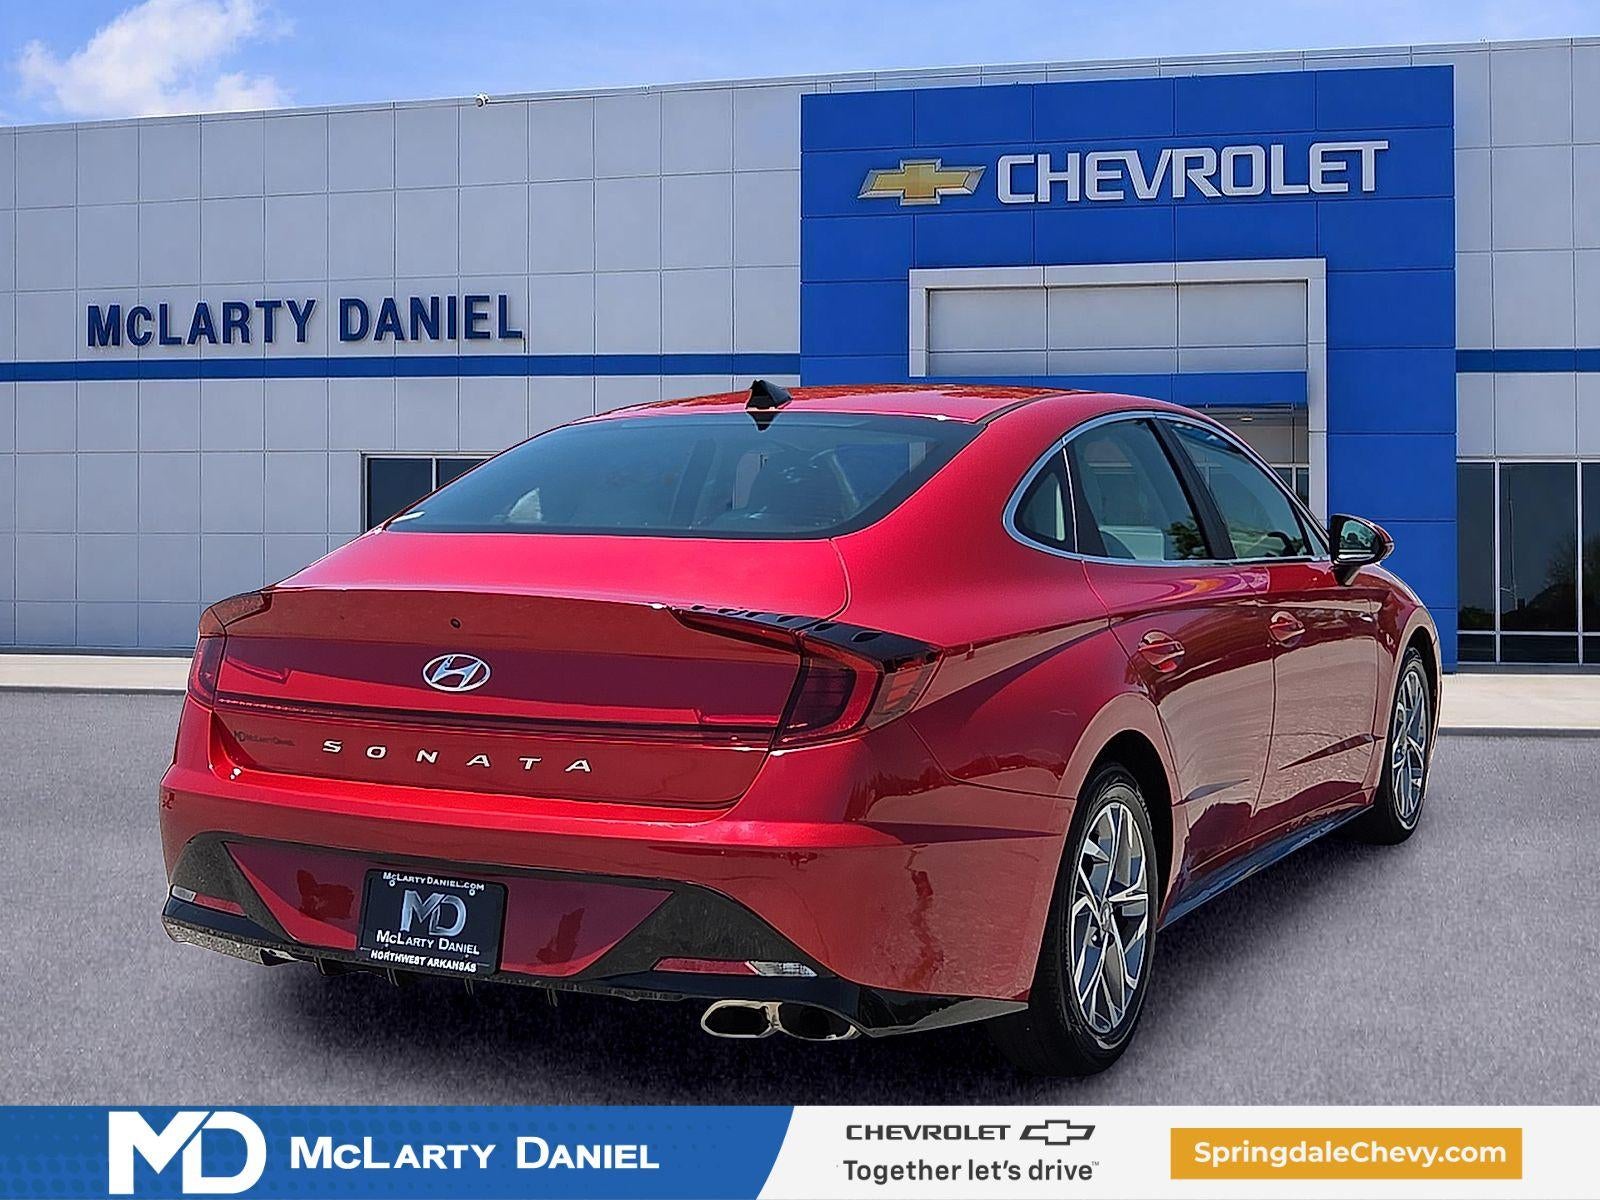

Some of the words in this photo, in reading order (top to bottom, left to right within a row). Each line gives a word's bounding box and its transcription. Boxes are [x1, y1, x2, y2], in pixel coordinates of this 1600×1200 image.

[997, 140, 1389, 204] CHEVROLET
[339, 294, 523, 341] DANIEL
[322, 740, 592, 773] SONATA
[370, 949, 426, 966] NORTHWEST
[426, 956, 477, 973] ARKANSAS
